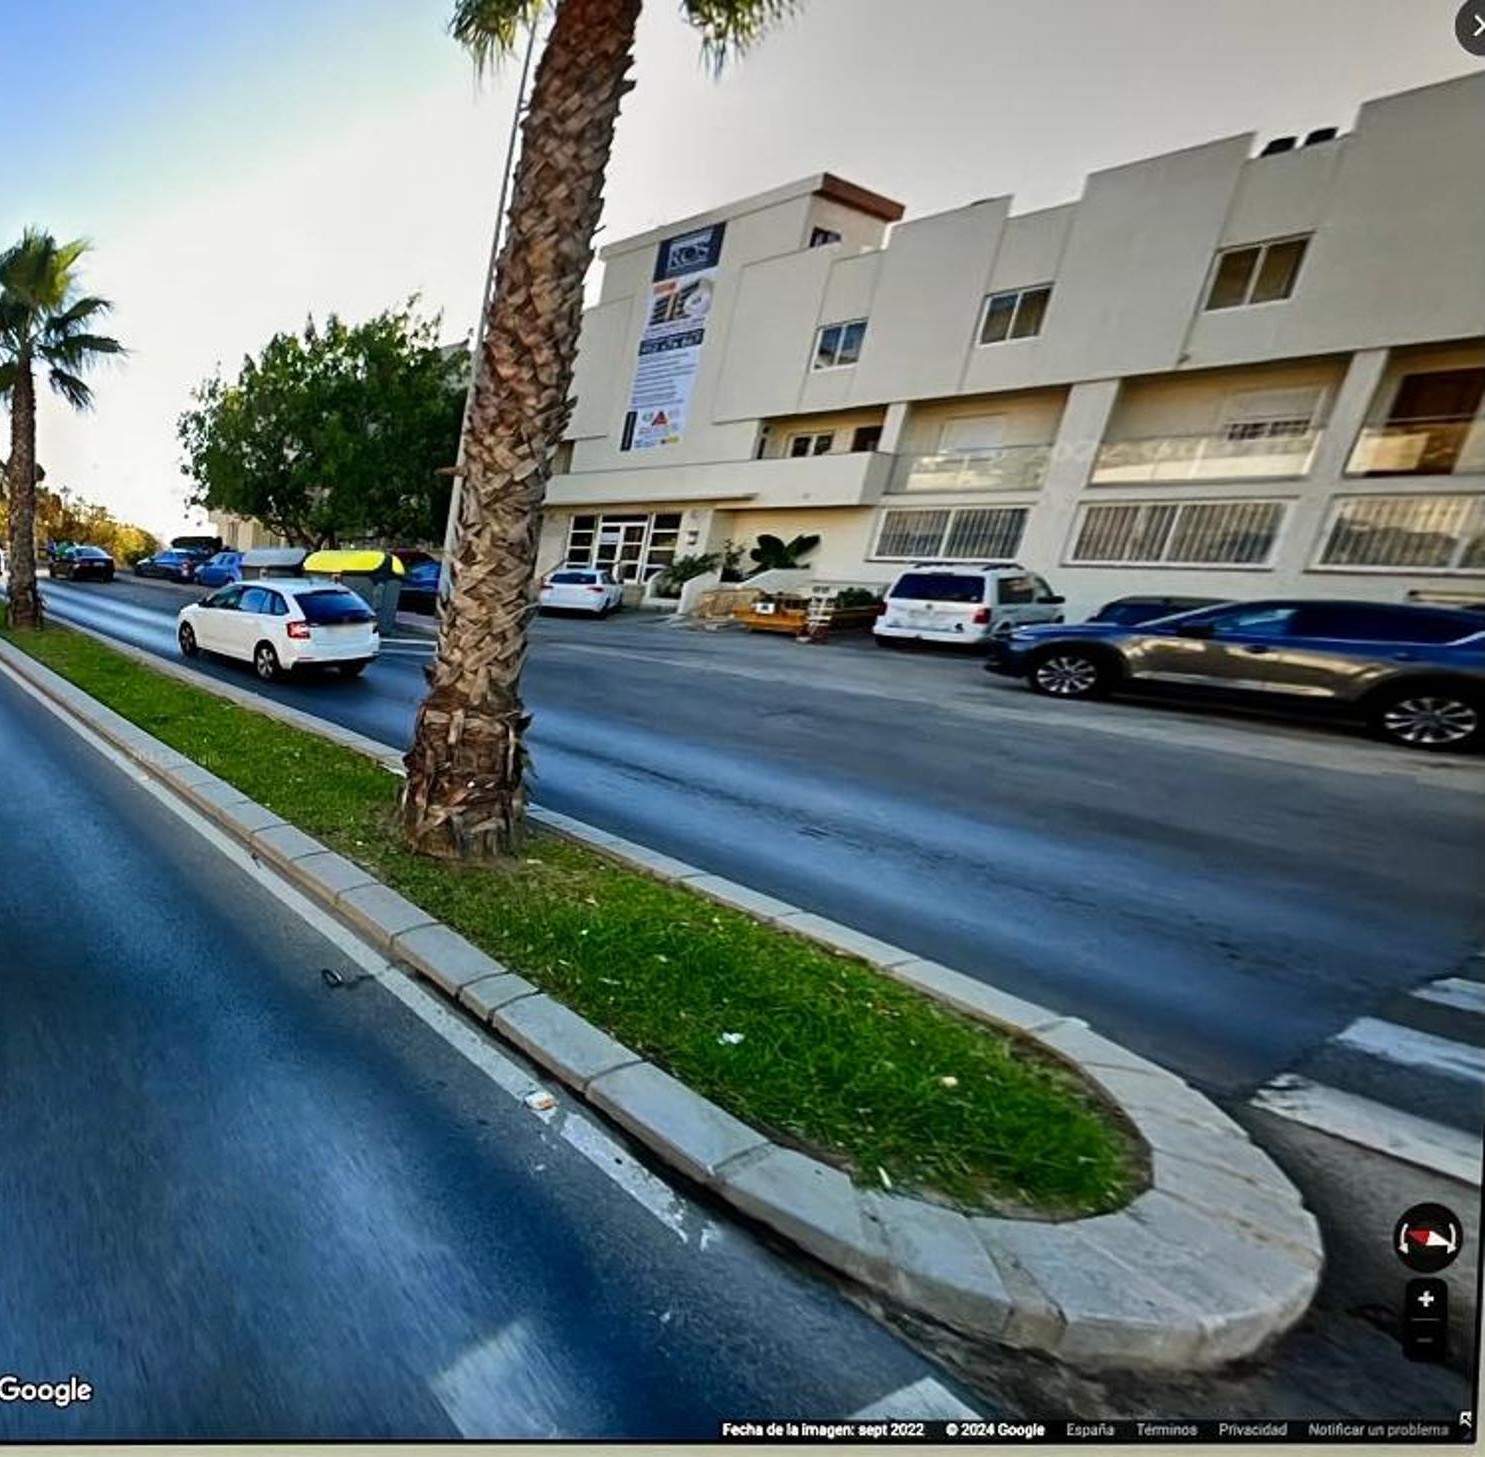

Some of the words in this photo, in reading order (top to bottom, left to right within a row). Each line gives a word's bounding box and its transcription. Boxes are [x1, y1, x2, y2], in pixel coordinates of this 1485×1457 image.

[722, 1422, 764, 1437] Fecha
[766, 1422, 784, 1437] de
[786, 1422, 799, 1437] la
[801, 1422, 856, 1440] imagen:
[858, 1423, 889, 1440] sept
[891, 1422, 925, 1437] 2022
[961, 1422, 996, 1437] 2024
[998, 1422, 1046, 1440] Google
[1066, 1422, 1115, 1438] España
[1136, 1422, 1198, 1437] Términos
[1219, 1422, 1288, 1437] Privacidad
[1308, 1422, 1365, 1437] Notificar
[1367, 1424, 1385, 1437] un
[1387, 1422, 1449, 1438] problema
